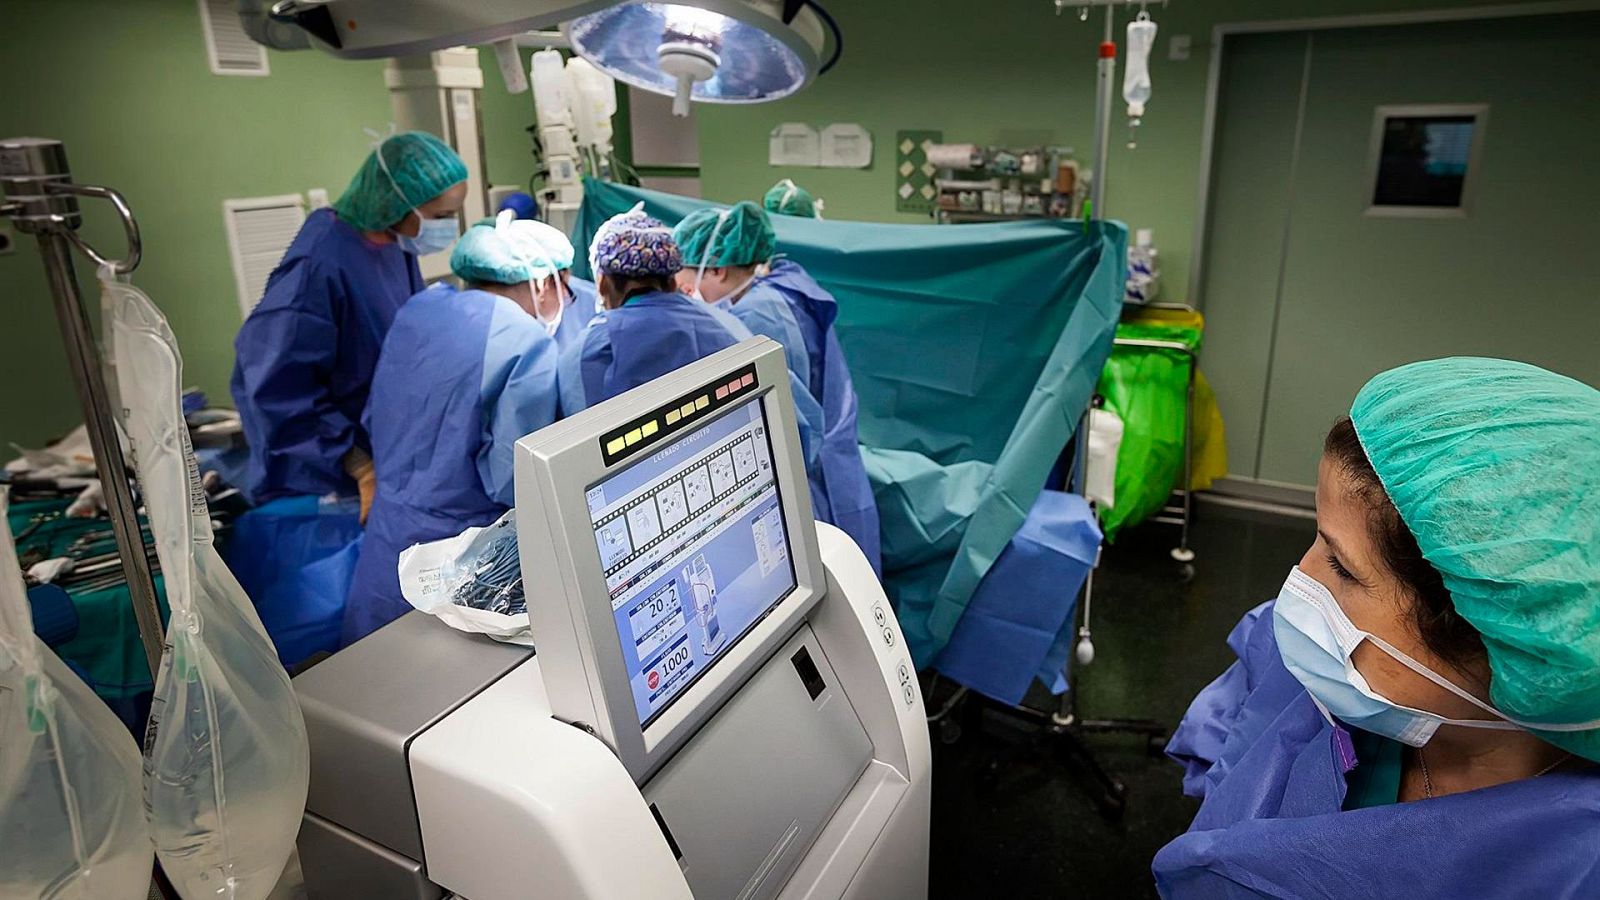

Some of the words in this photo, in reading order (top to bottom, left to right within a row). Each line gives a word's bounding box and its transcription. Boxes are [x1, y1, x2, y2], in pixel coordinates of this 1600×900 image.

[652, 444, 680, 463] LLENADO
[682, 427, 711, 447] CIRCUITO
[650, 589, 676, 618] 20.2
[662, 646, 689, 677] 1000
